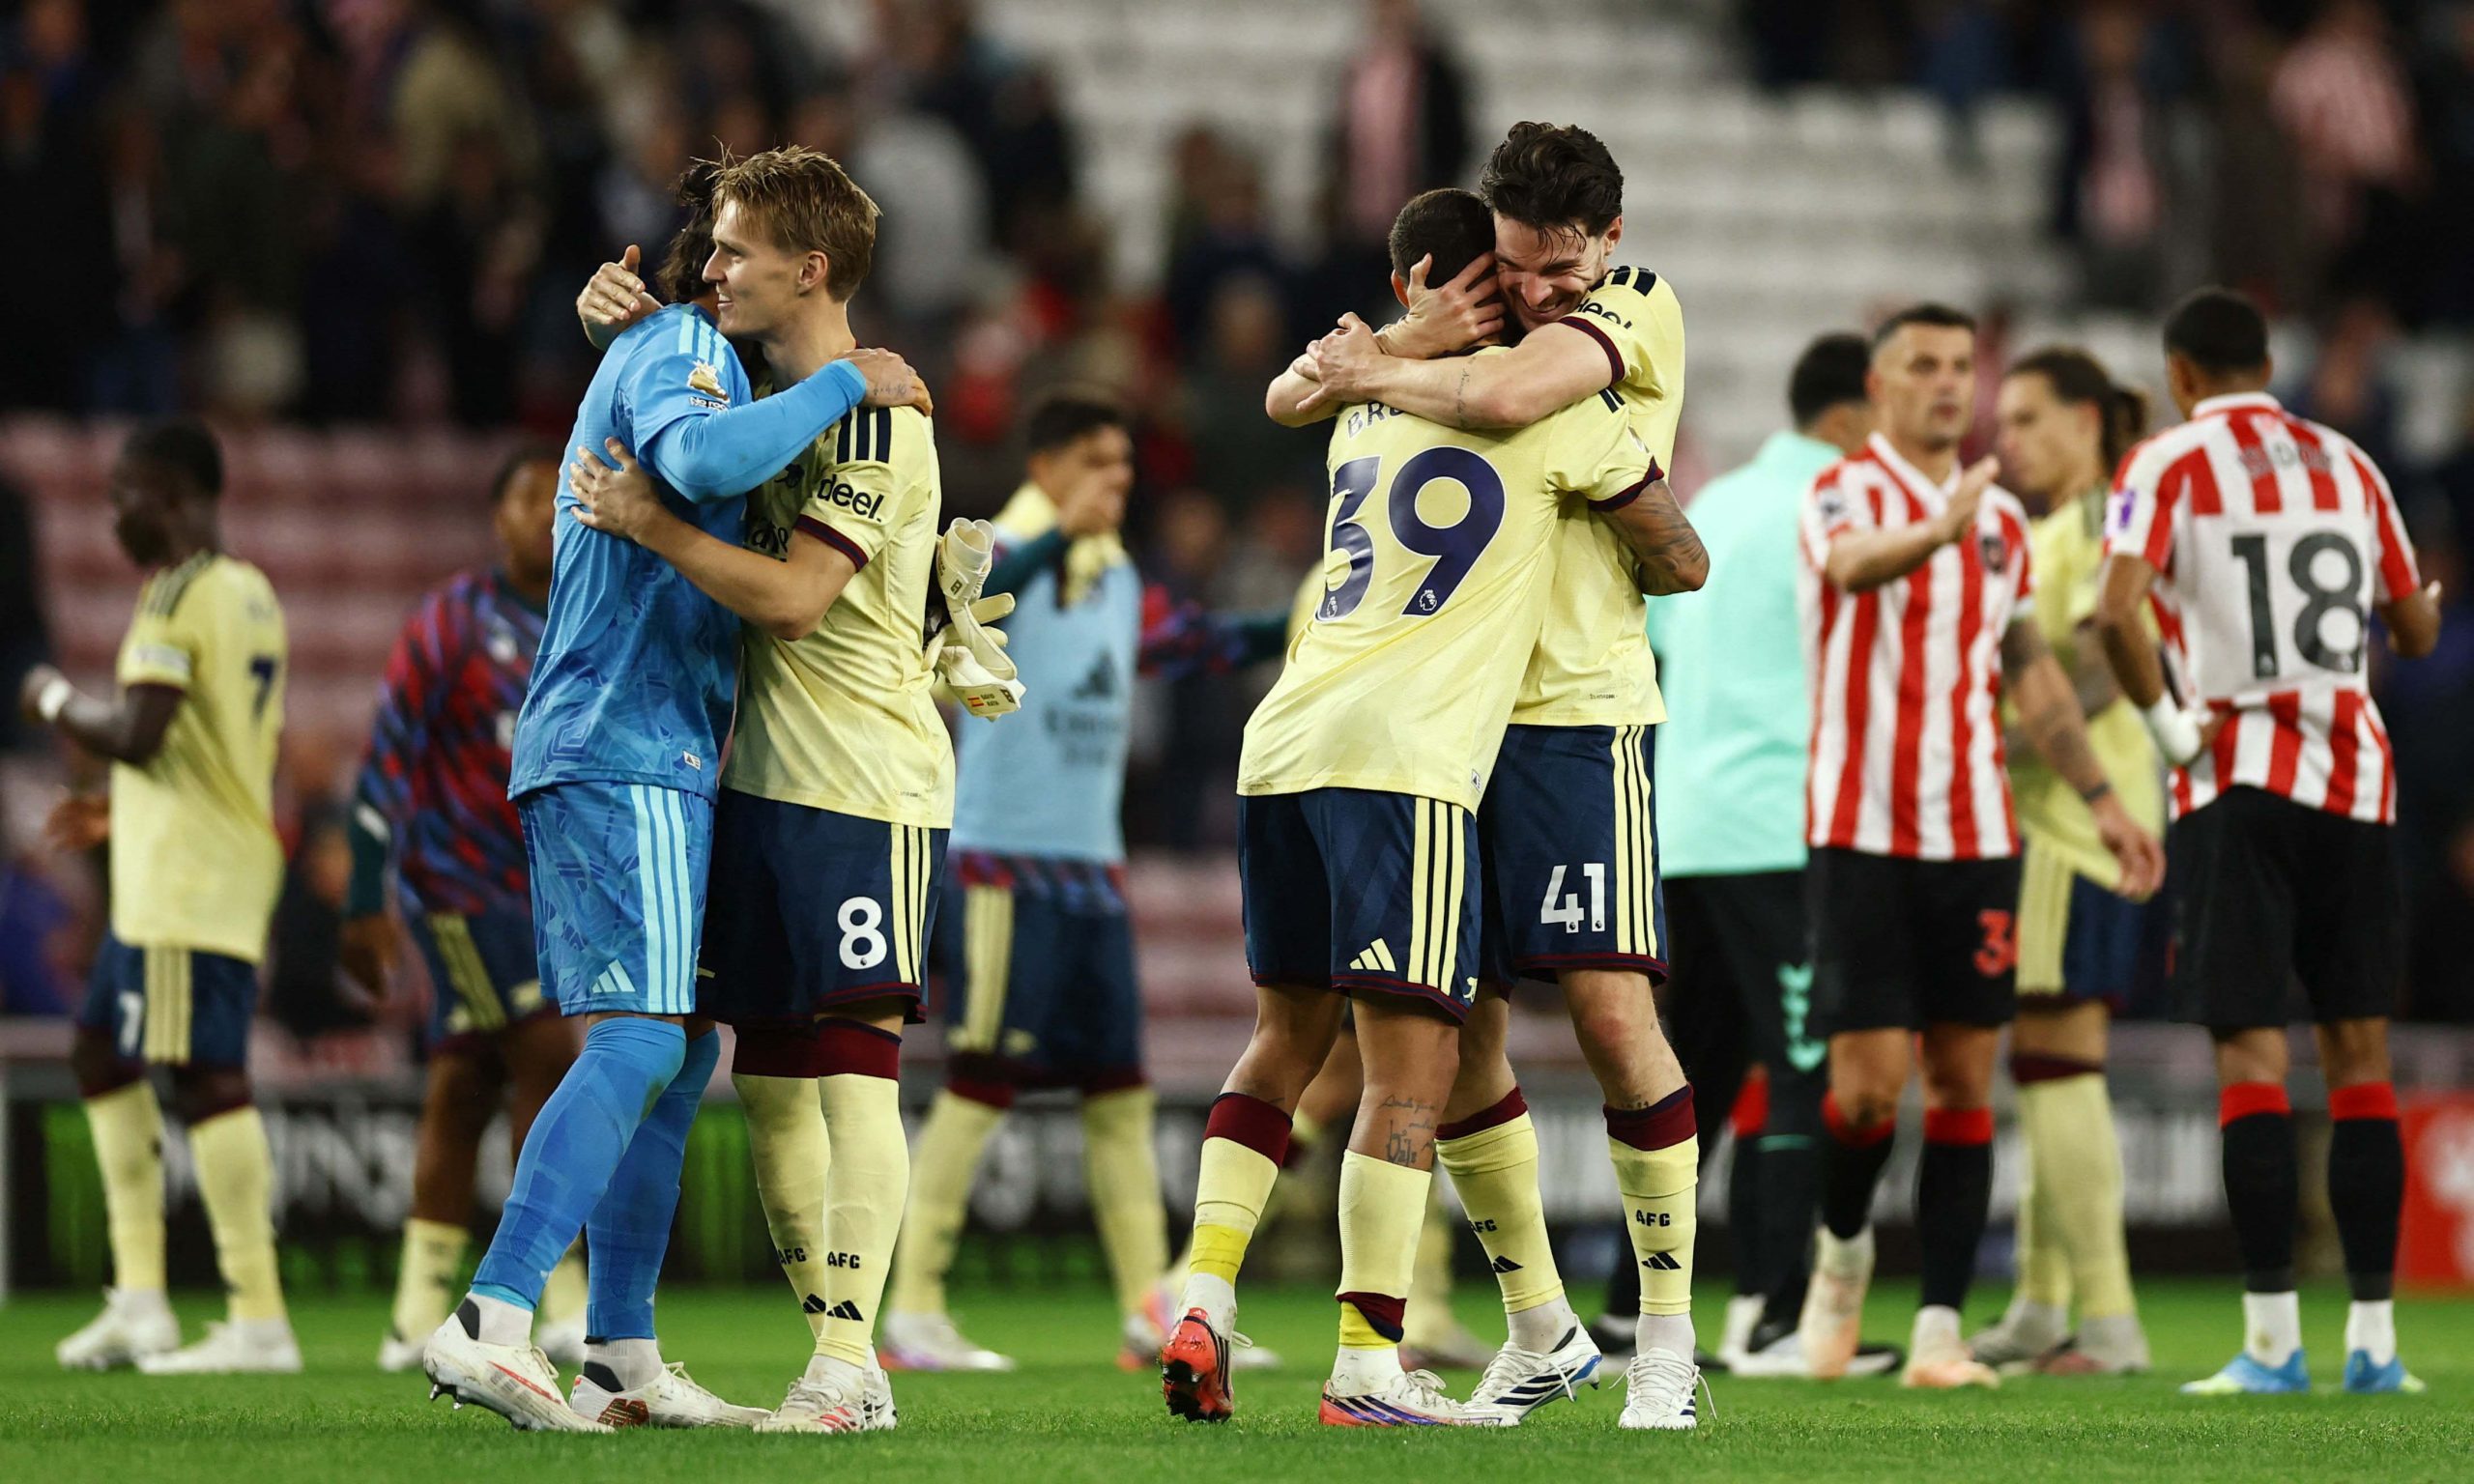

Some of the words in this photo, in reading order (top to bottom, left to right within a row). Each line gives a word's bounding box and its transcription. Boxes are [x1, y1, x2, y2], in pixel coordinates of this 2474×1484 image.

[1315, 445, 1507, 621] 39
[2230, 531, 2363, 680] 18
[248, 654, 274, 723] 7
[837, 896, 888, 970] 8
[1540, 863, 1605, 934] 41
[1636, 1210, 1671, 1228] AFC
[827, 1251, 860, 1270] AFC
